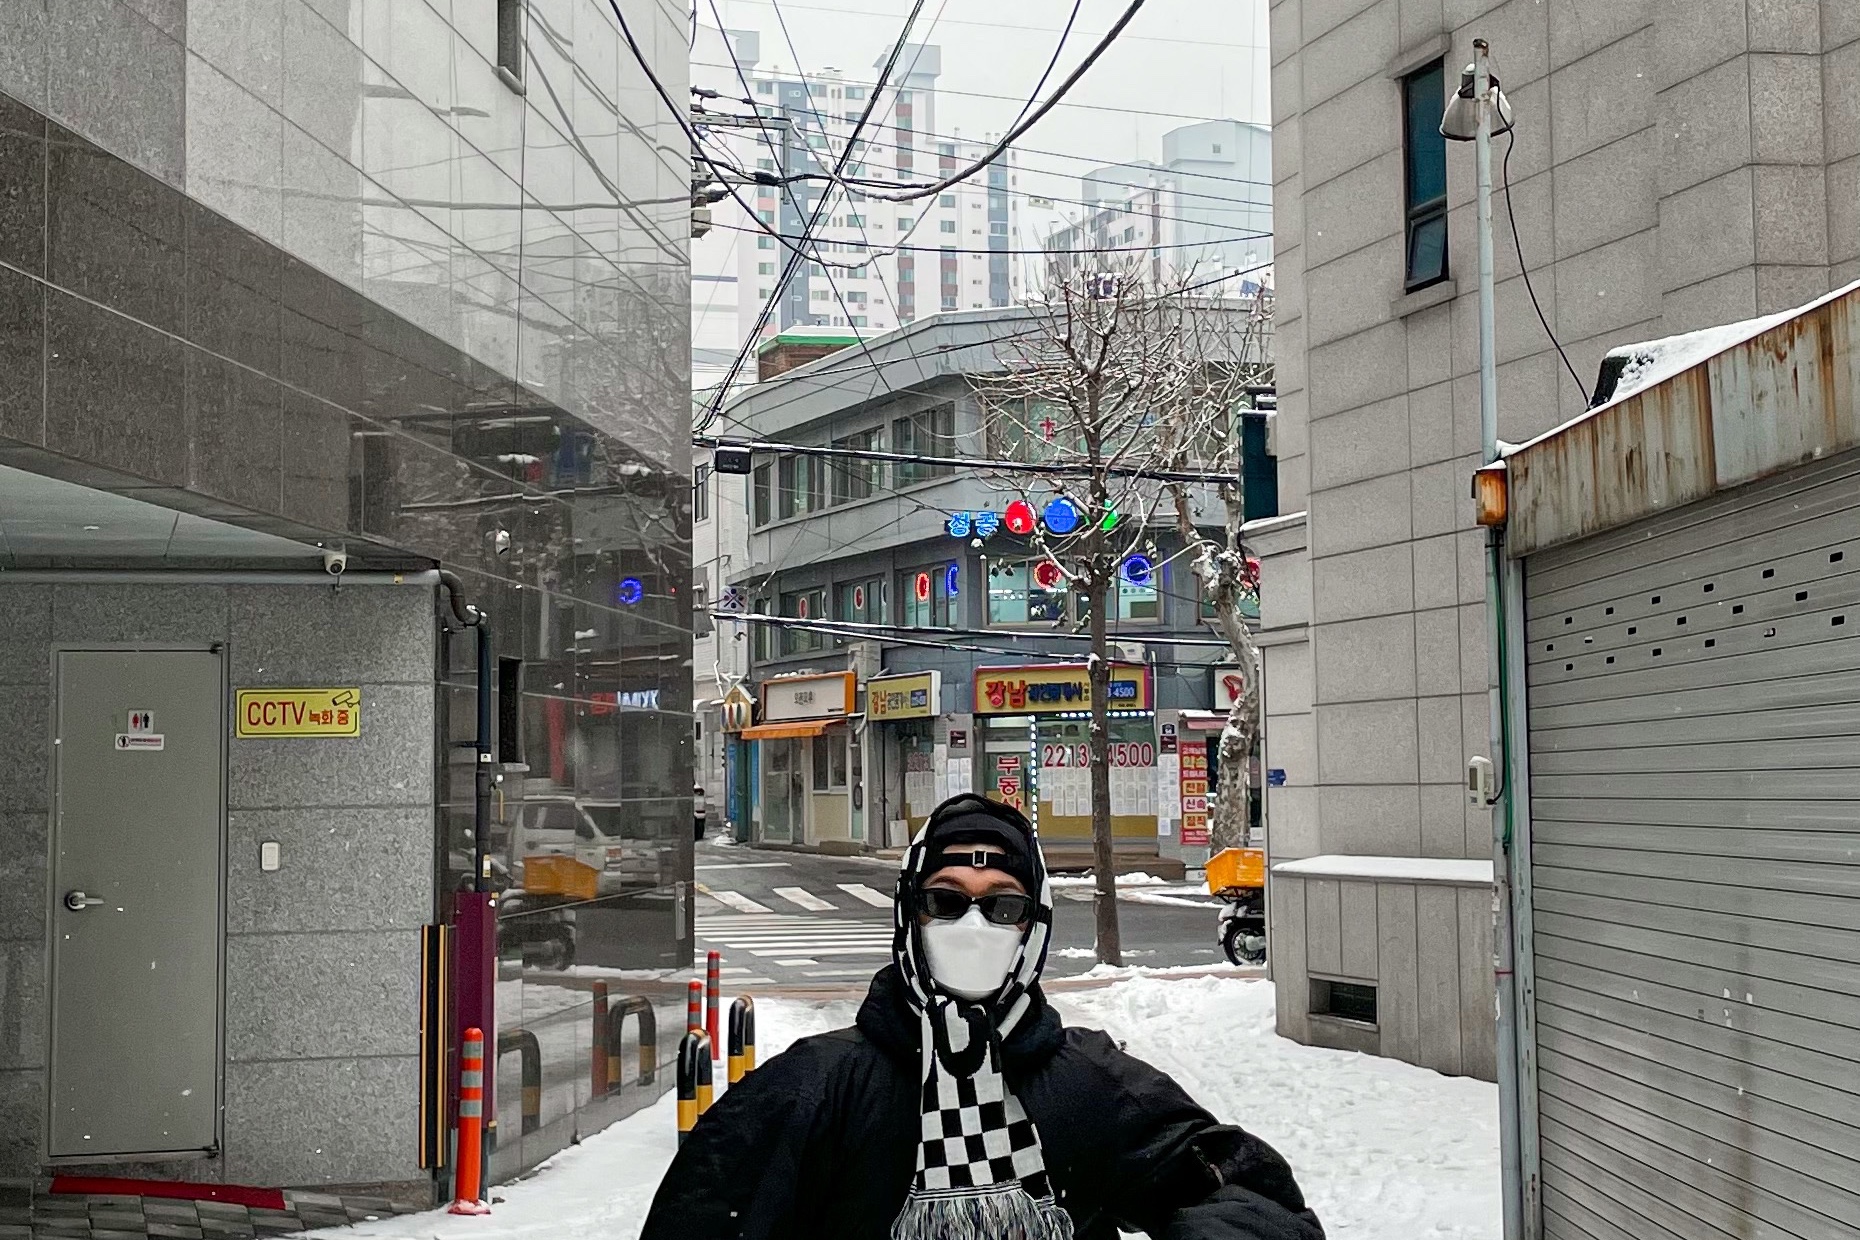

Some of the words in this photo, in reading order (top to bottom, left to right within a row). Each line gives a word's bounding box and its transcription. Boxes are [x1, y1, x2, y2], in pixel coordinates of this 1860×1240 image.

[985, 680, 1026, 708] 강남
[247, 701, 306, 726] CCTV
[309, 709, 333, 725] 녹화
[337, 709, 349, 725] 중
[1044, 744, 1089, 768] 2213
